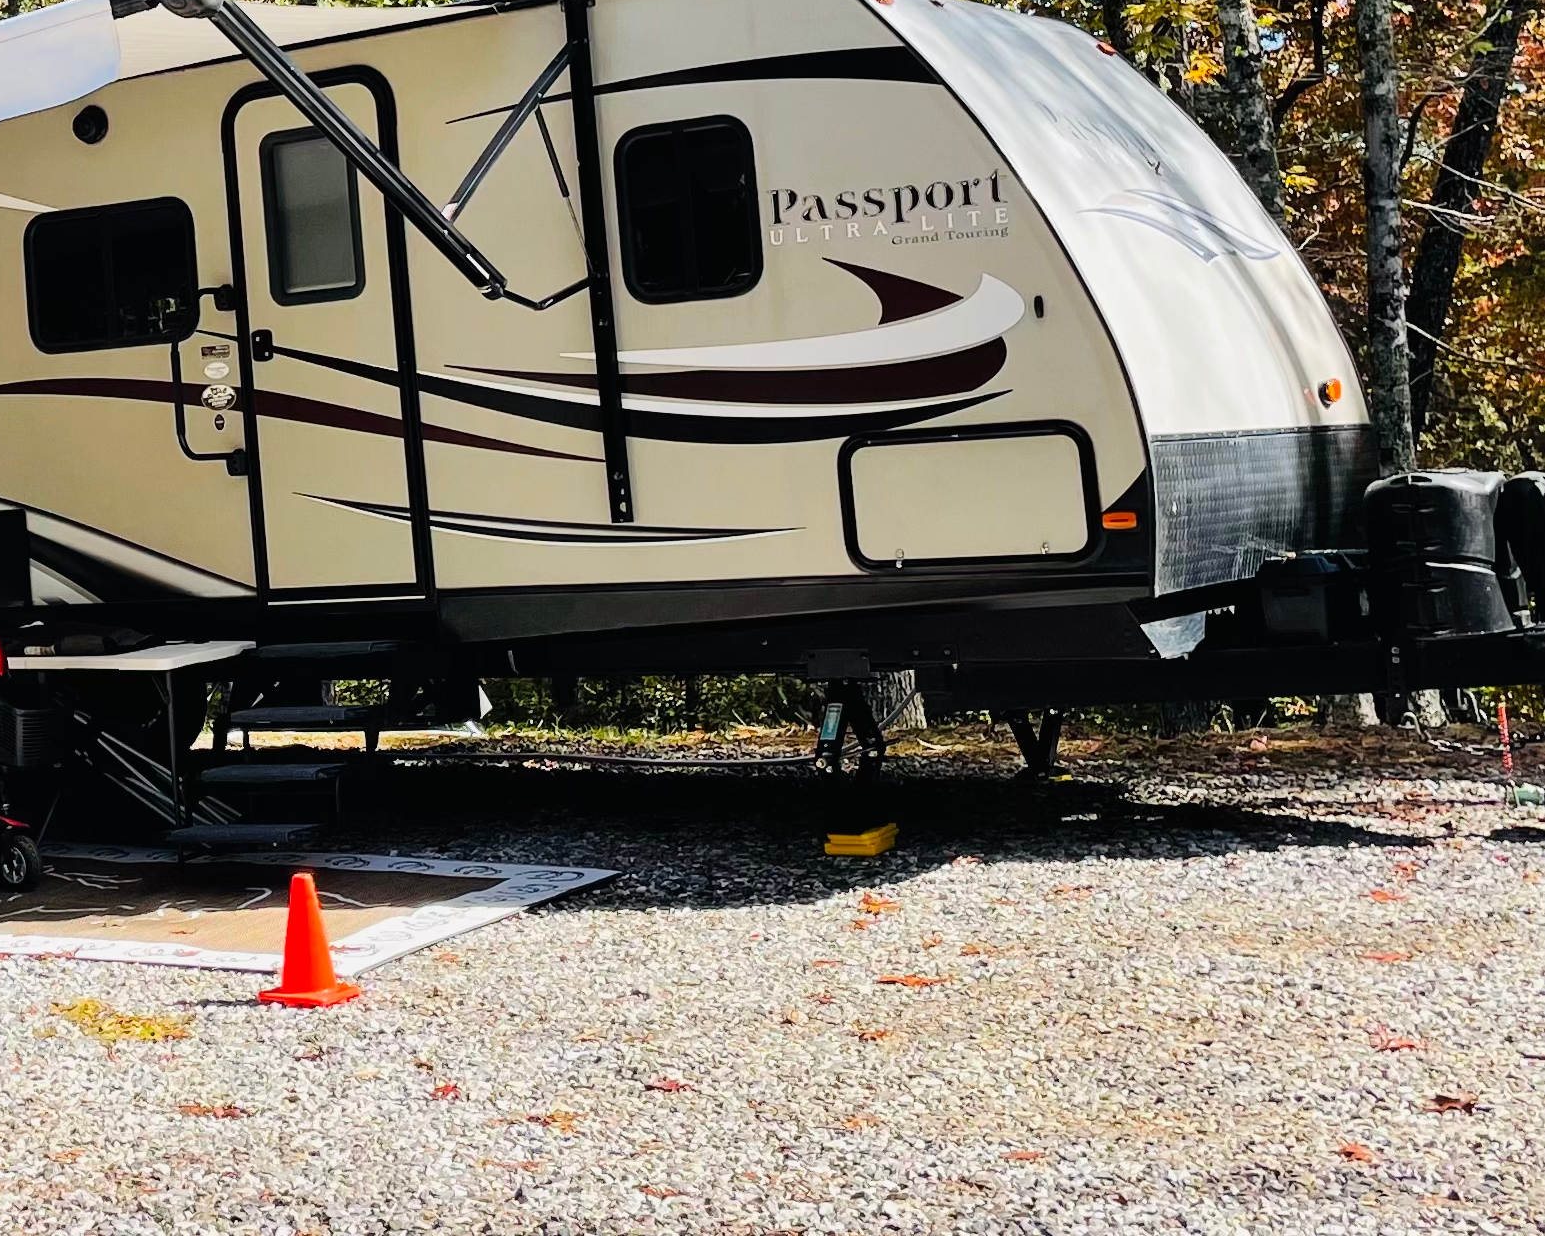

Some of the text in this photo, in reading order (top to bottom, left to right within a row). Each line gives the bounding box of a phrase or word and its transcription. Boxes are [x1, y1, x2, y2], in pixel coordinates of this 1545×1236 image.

[767, 168, 1009, 226] Passport
[769, 208, 1009, 245] ULTRA LITE
[891, 227, 1009, 245] Grand Touring
